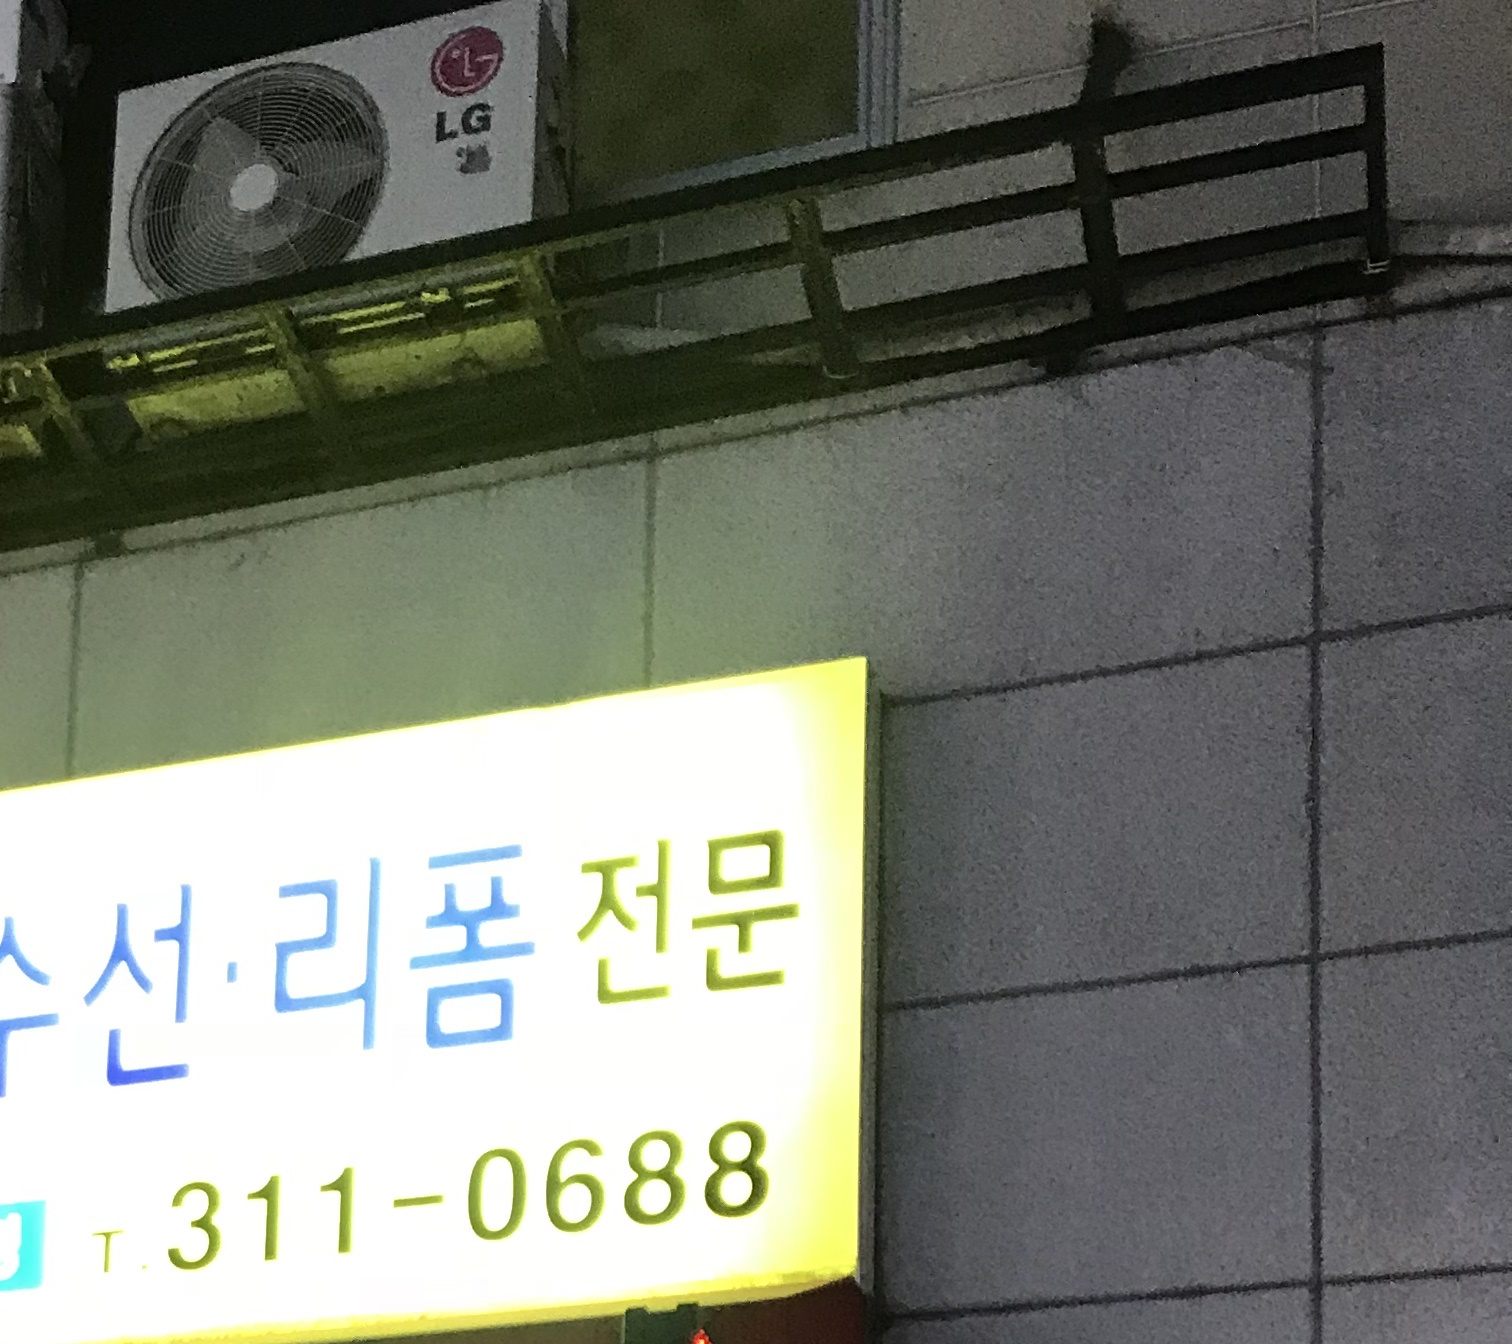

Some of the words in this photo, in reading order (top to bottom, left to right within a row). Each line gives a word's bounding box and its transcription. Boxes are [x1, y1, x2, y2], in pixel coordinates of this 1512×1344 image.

[435, 103, 494, 143] LG
[576, 828, 801, 1005] 전문
[166, 1120, 771, 1271] 311-0688
